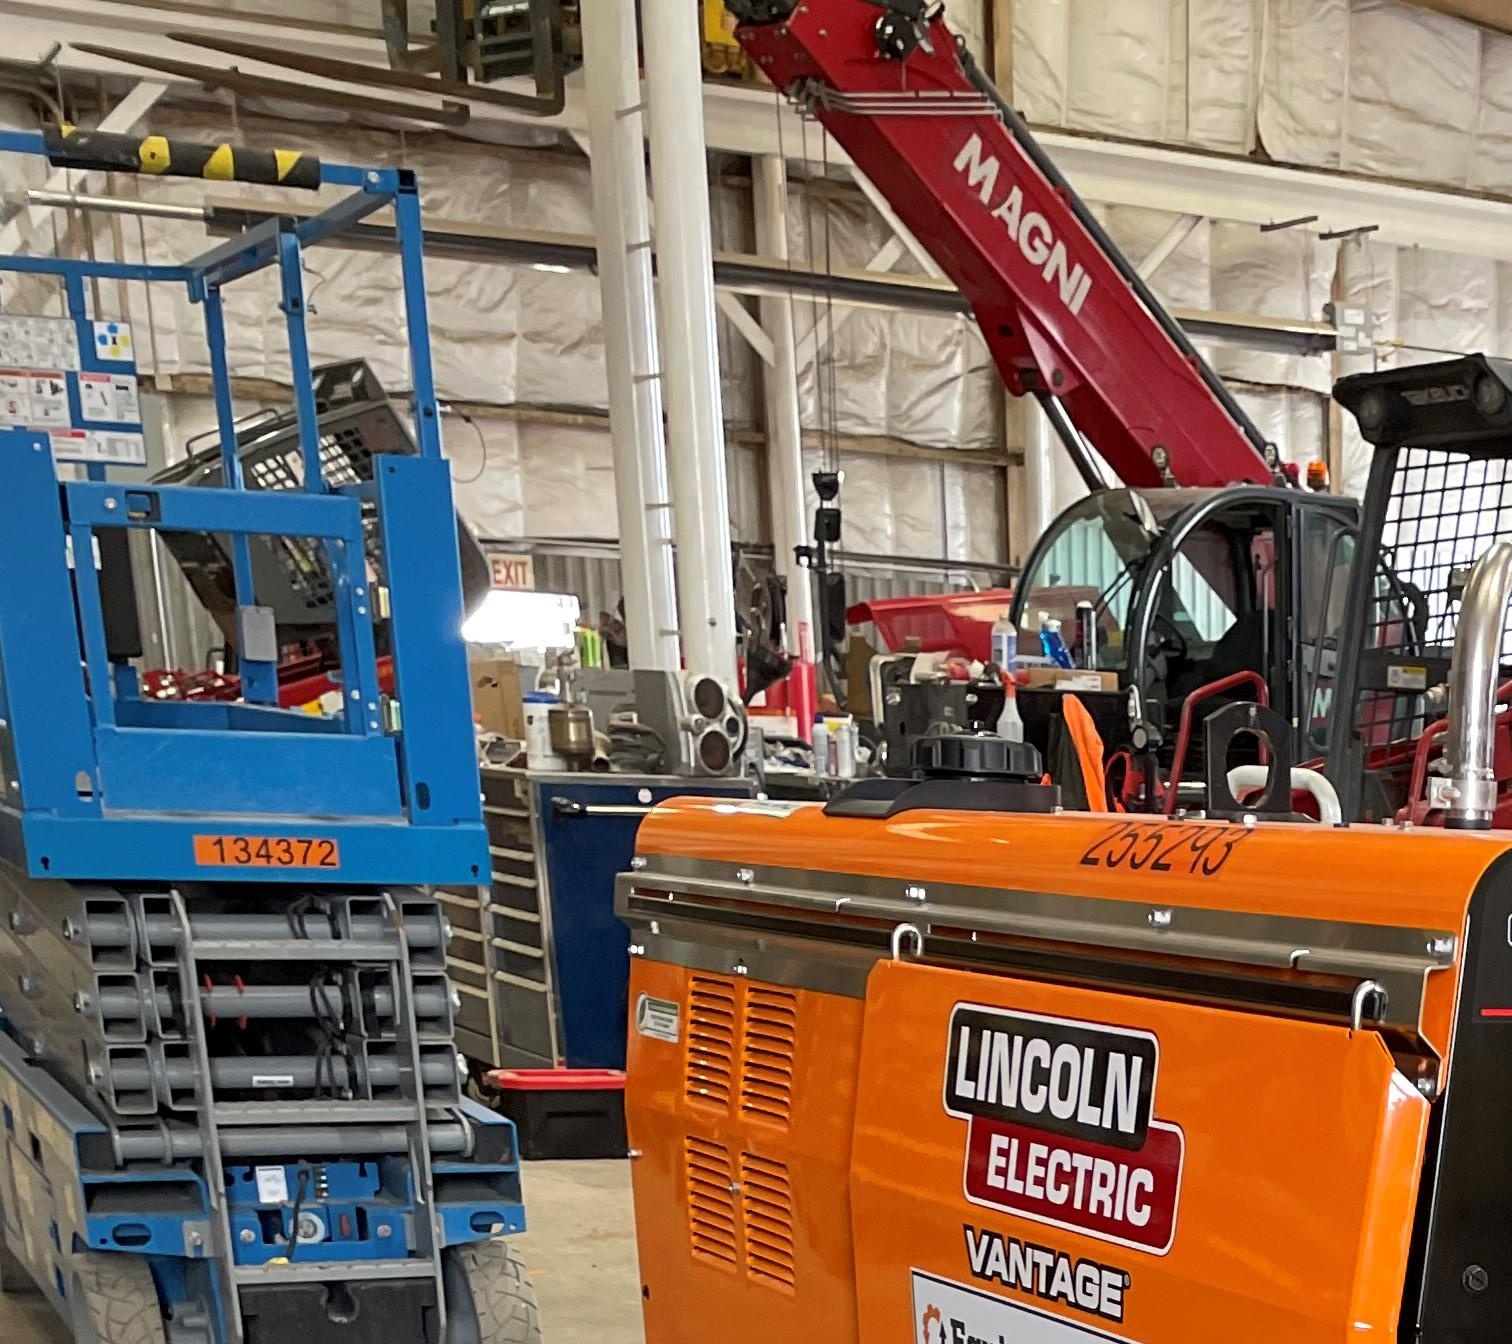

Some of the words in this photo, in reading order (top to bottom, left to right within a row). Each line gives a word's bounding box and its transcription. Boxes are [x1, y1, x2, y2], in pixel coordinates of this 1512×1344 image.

[953, 126, 1093, 316] MAGNI
[492, 559, 528, 585] EXIT
[212, 836, 337, 867] 134372
[1080, 821, 1254, 876] 255293
[954, 1025, 1144, 1135] LINCOLN
[986, 1133, 1155, 1228] ELECTRIC
[965, 1228, 1124, 1318] VANTAGE
